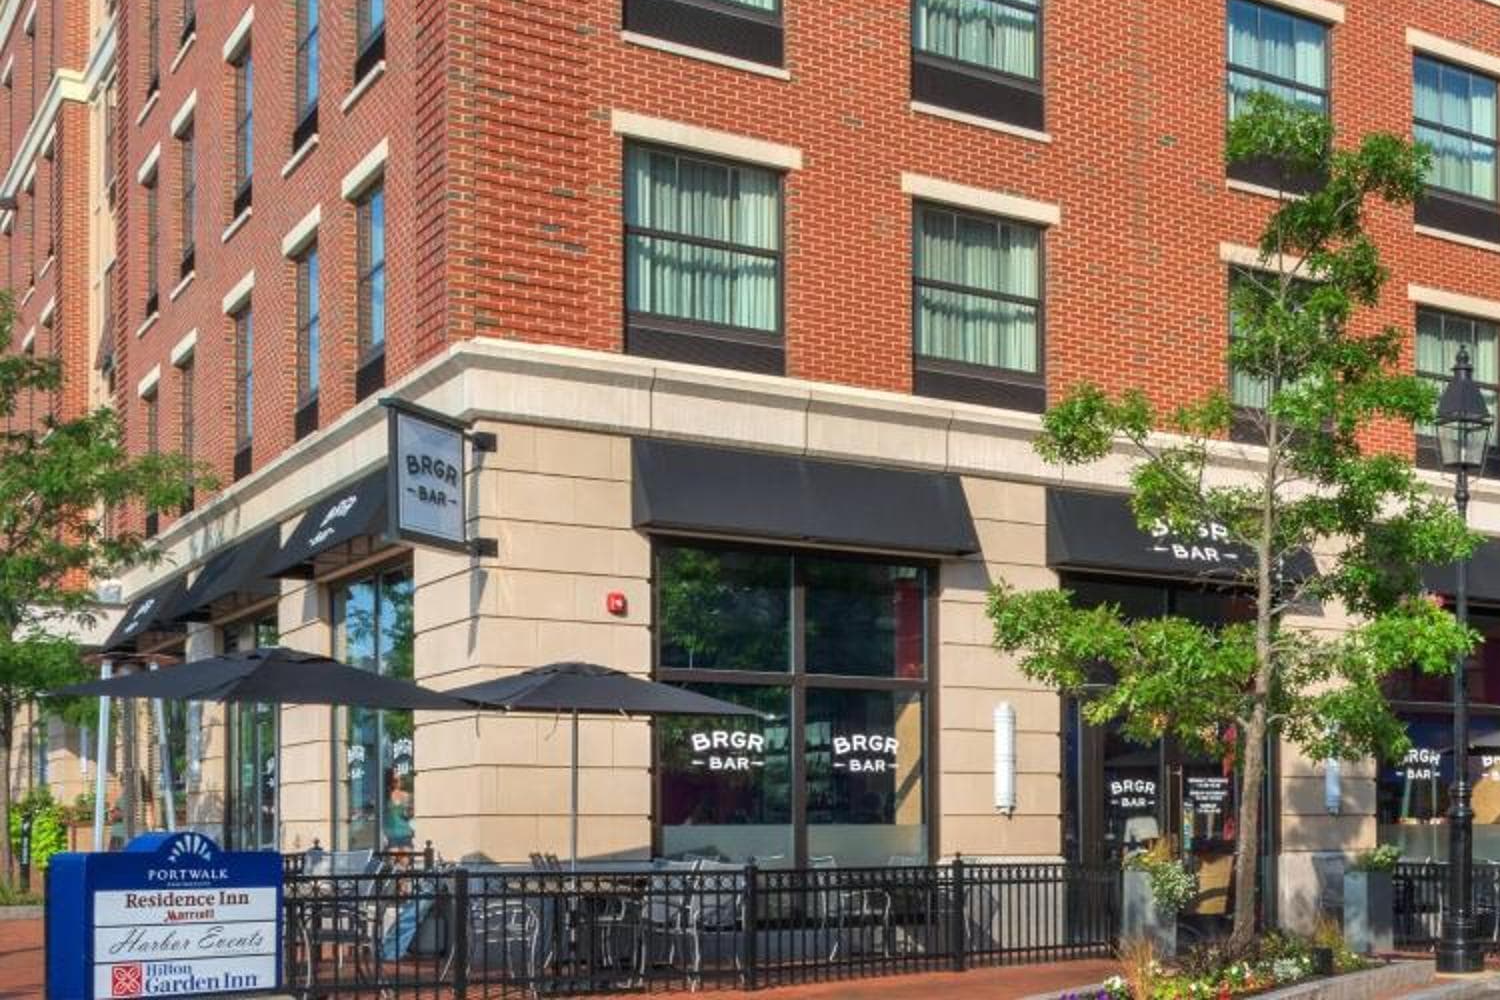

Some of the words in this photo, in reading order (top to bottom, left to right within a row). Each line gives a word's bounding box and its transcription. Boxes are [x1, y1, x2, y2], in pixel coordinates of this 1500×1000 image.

[406, 454, 458, 488] BRGR
[418, 486, 448, 506] BAR
[1172, 543, 1221, 562] BAR
[691, 730, 765, 753] BRGR
[833, 734, 899, 755] BRGR
[709, 756, 750, 771] BAR
[849, 759, 886, 773] BAR
[1407, 768, 1432, 780] BAR
[1111, 779, 1157, 795] BRGR
[1121, 797, 1146, 808] BAR
[148, 868, 229, 881] PORTWALK
[125, 892, 216, 909] Residence
[219, 890, 250, 906] Inn
[163, 909, 216, 923] Marriott
[110, 925, 190, 955] Harbor
[198, 926, 265, 950] Events
[145, 963, 193, 977] Hilton
[144, 974, 219, 994] Garden
[223, 972, 258, 991] Inn
